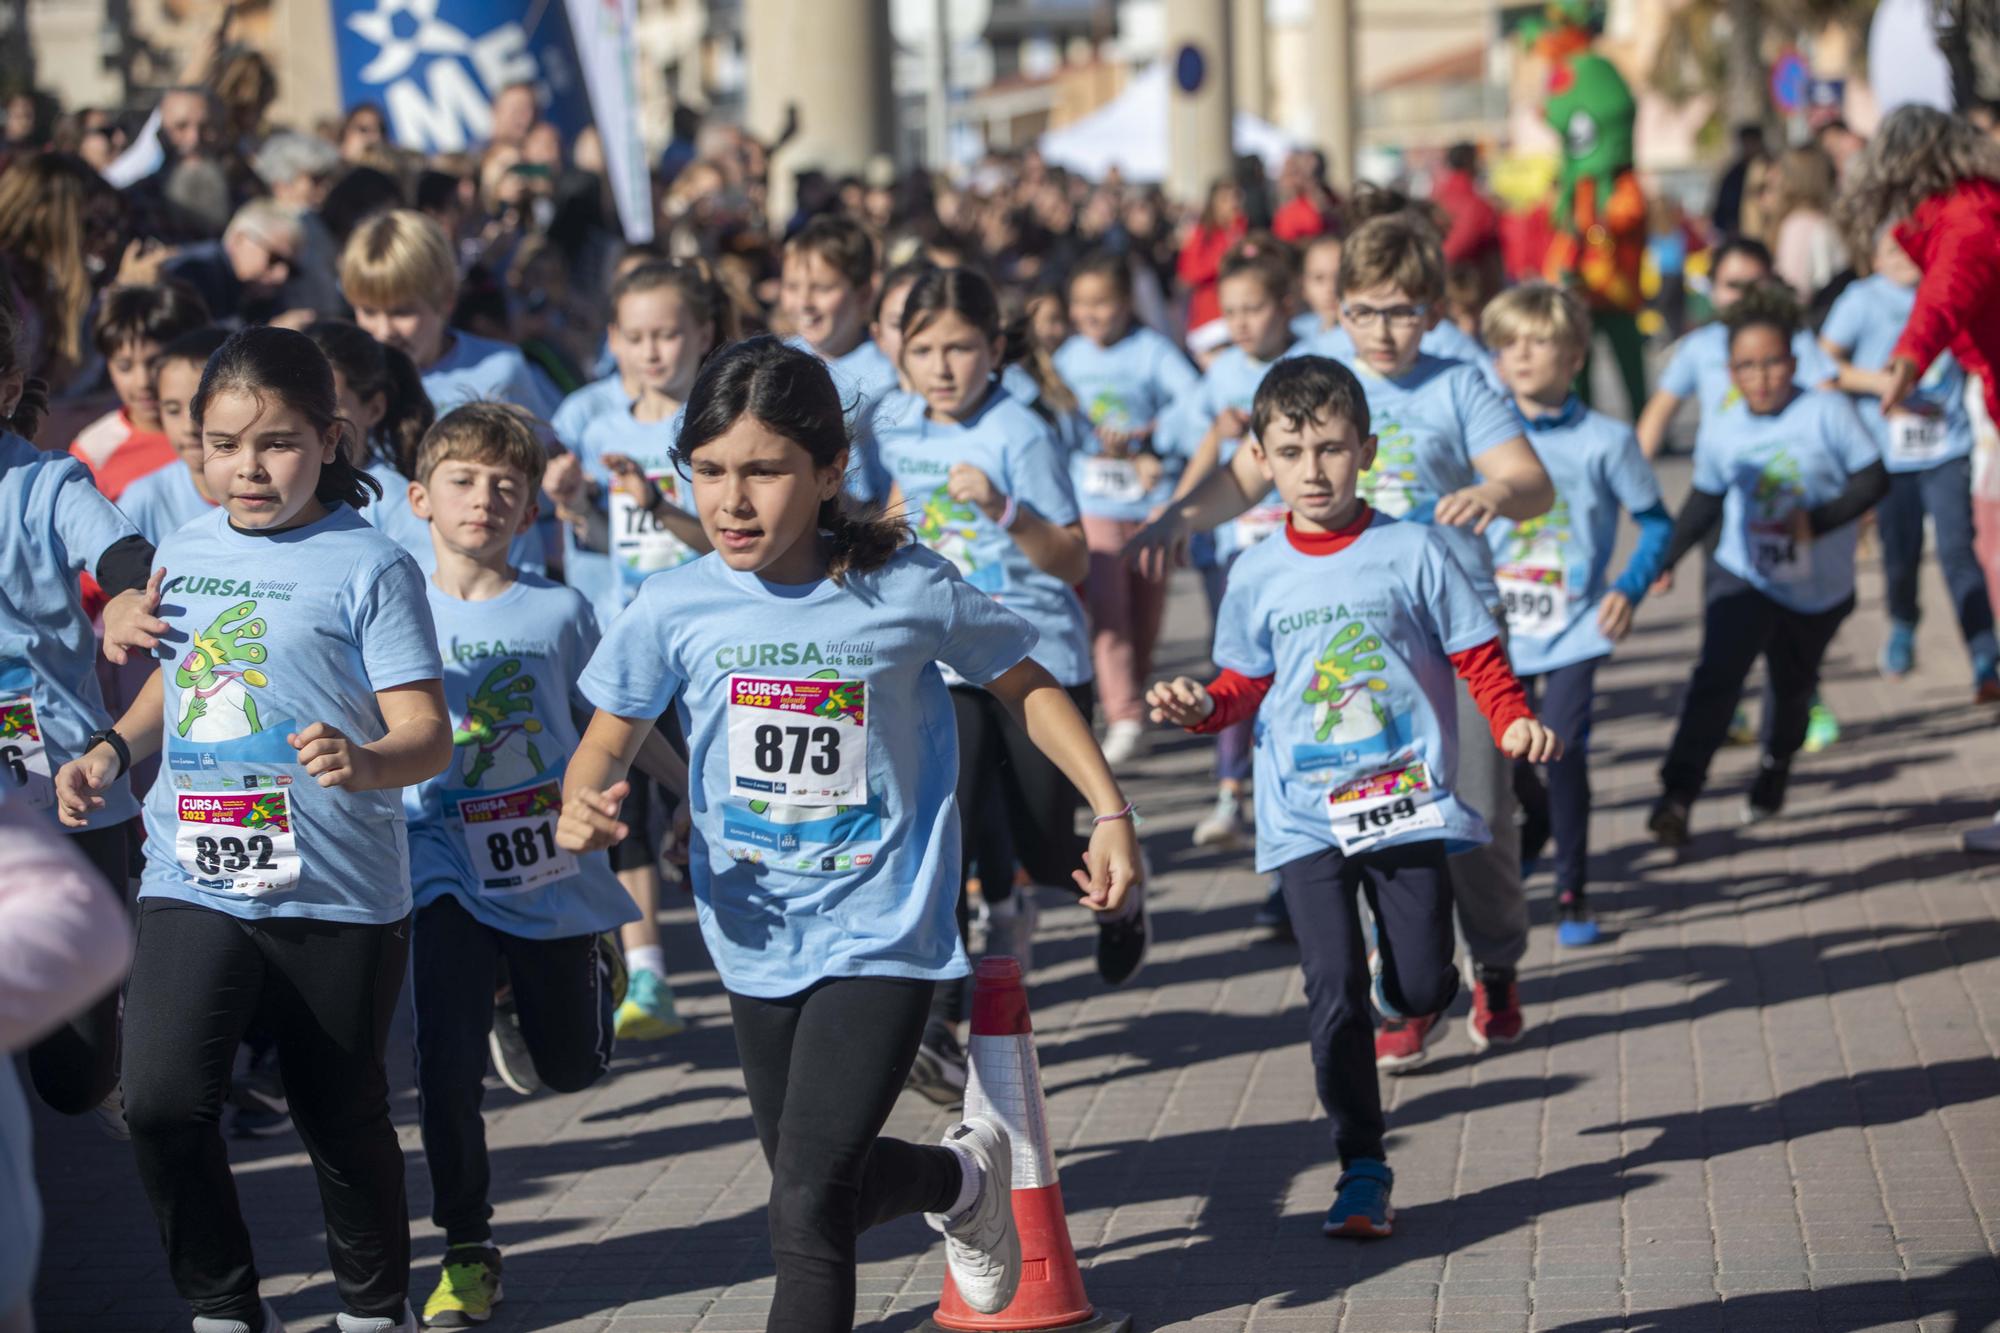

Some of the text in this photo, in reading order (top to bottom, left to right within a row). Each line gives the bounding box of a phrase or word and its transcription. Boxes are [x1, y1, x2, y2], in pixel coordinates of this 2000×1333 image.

[171, 575, 299, 598] CURSA infantil
[251, 589, 292, 601] de Reis
[1277, 603, 1350, 635] CURSA
[715, 640, 875, 669] CURSA infantil
[826, 654, 873, 666] de Reis
[735, 681, 794, 697] CURSA
[735, 694, 772, 706] 2023
[755, 724, 841, 776] 873
[181, 799, 222, 811] CURSA
[182, 810, 206, 821] 2023
[1349, 797, 1417, 834] 769
[195, 834, 278, 876] 832
[486, 820, 556, 872] 881
